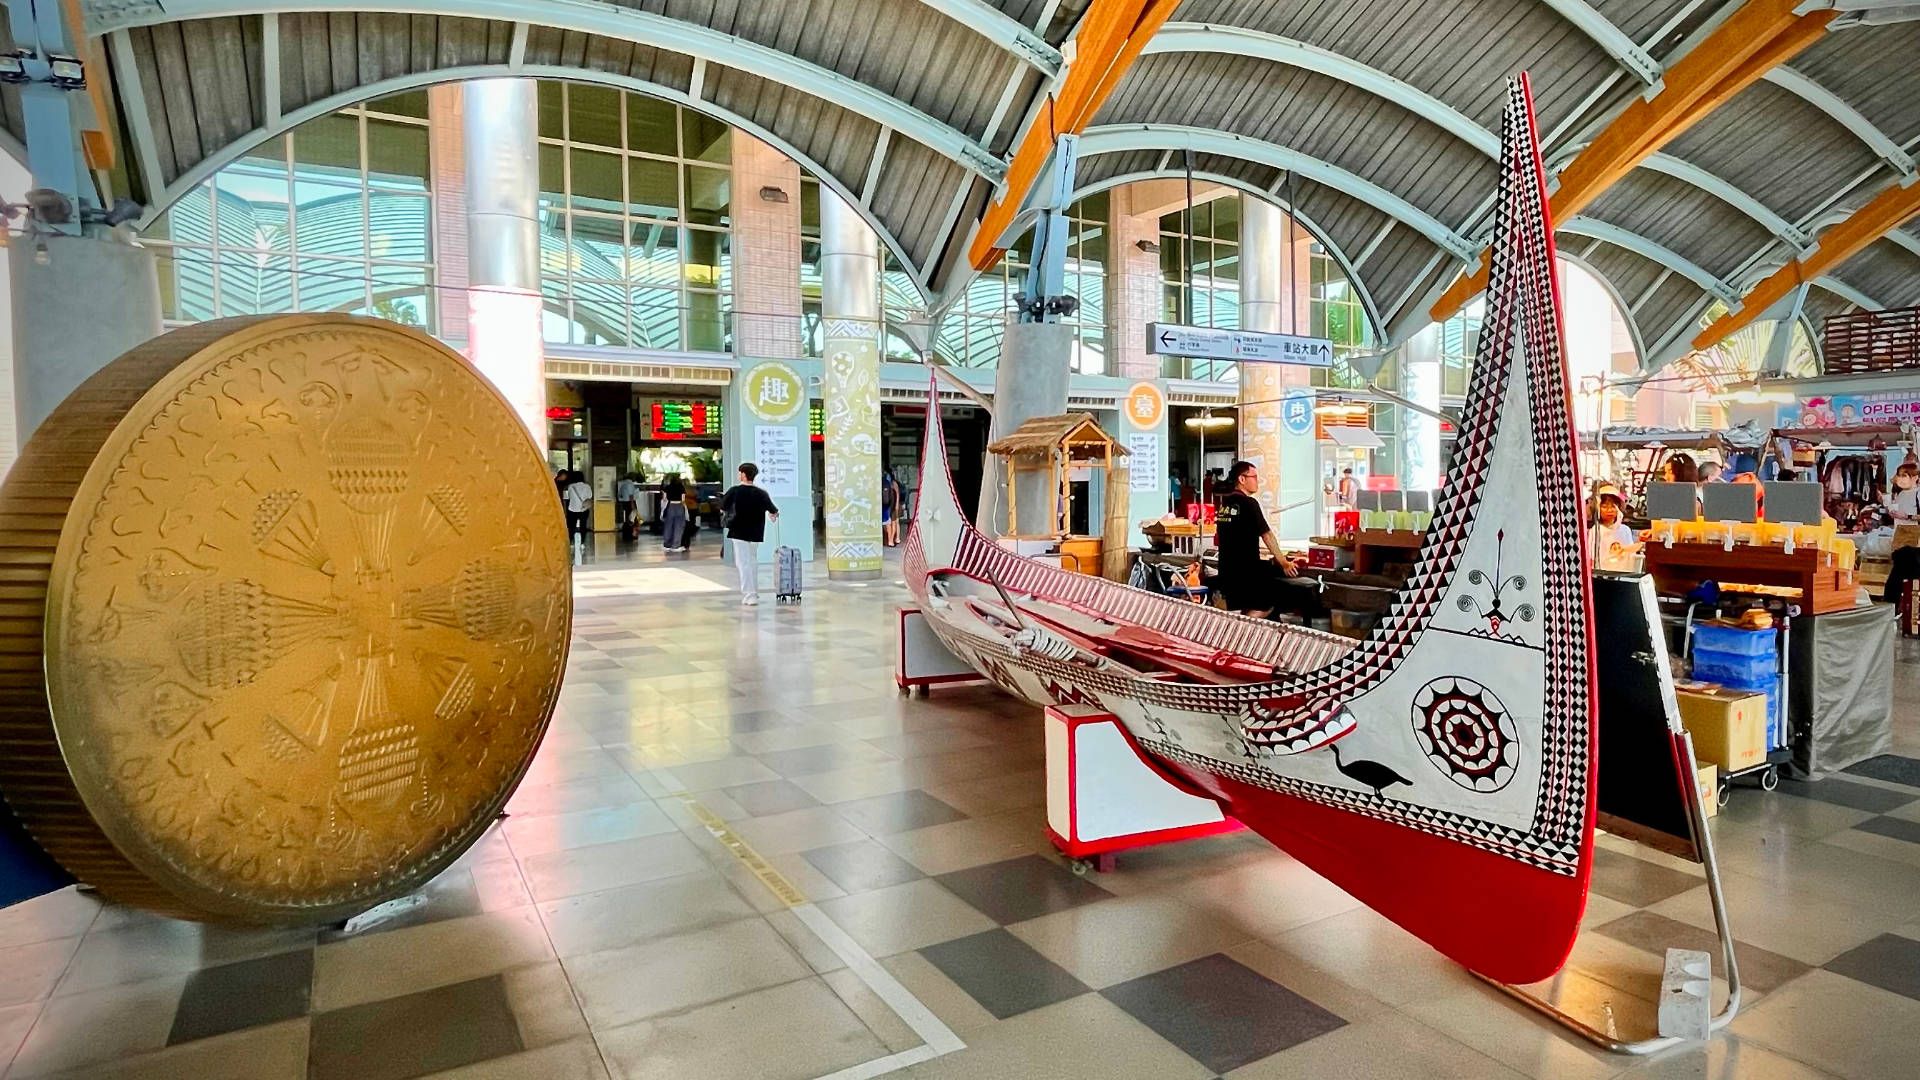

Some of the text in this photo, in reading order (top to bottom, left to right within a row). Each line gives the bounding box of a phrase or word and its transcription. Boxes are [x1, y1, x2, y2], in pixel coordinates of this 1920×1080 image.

[1283, 341, 1318, 356] 車站大廳
[759, 375, 790, 406] 趣
[1134, 393, 1155, 418] 臺
[1290, 401, 1307, 423] 東
[1862, 403, 1910, 415] OPEN!
